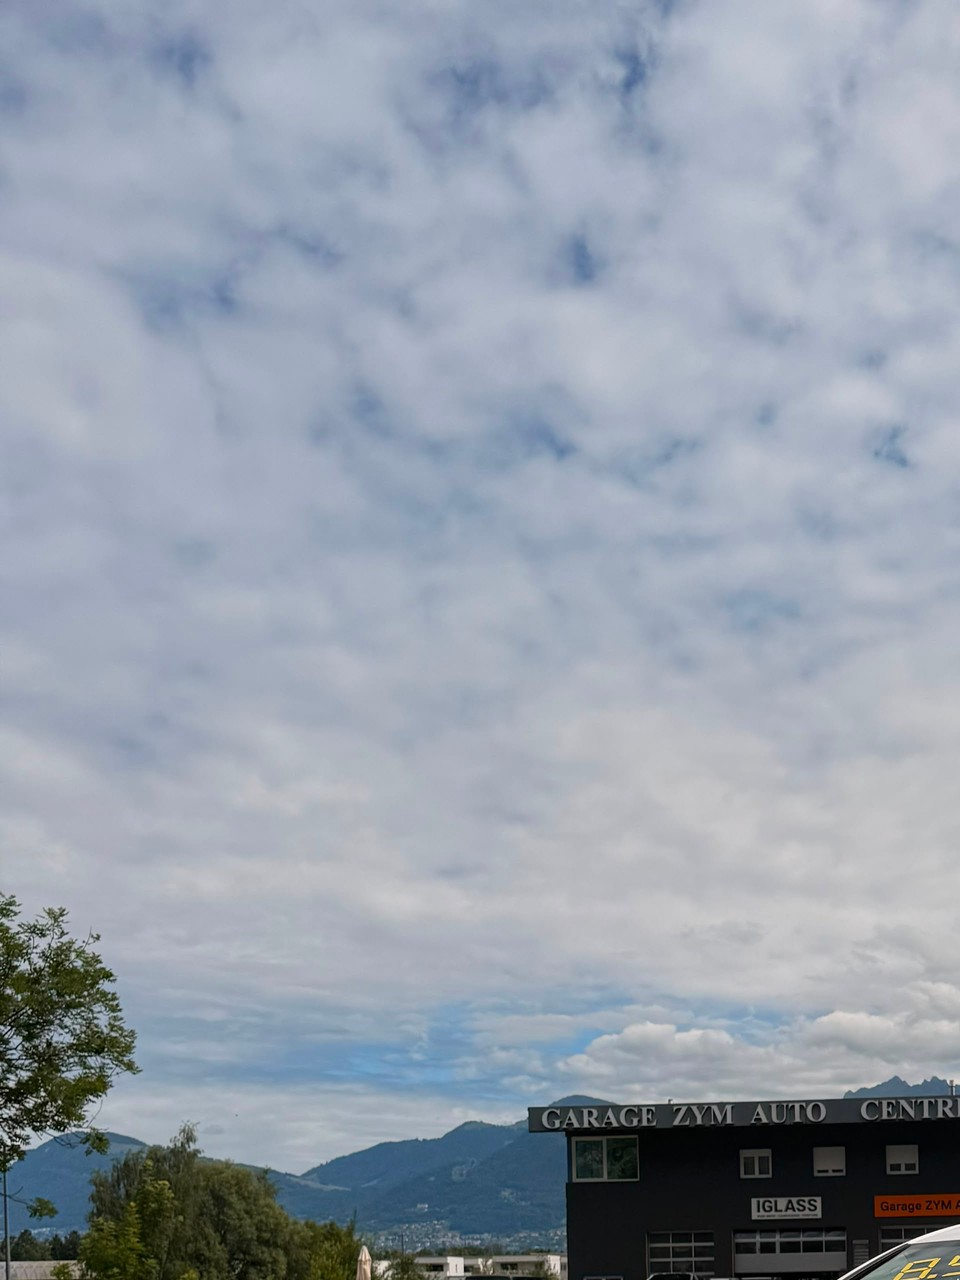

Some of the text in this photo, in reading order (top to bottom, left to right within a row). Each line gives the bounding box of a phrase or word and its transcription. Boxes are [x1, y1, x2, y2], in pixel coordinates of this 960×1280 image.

[541, 1105, 656, 1130] GARAGE
[673, 1103, 734, 1126] ZYM
[751, 1101, 826, 1124] AUTO
[756, 1198, 818, 1213] IGLASS
[880, 1201, 922, 1213] Garage
[925, 1200, 952, 1210] ZYM
